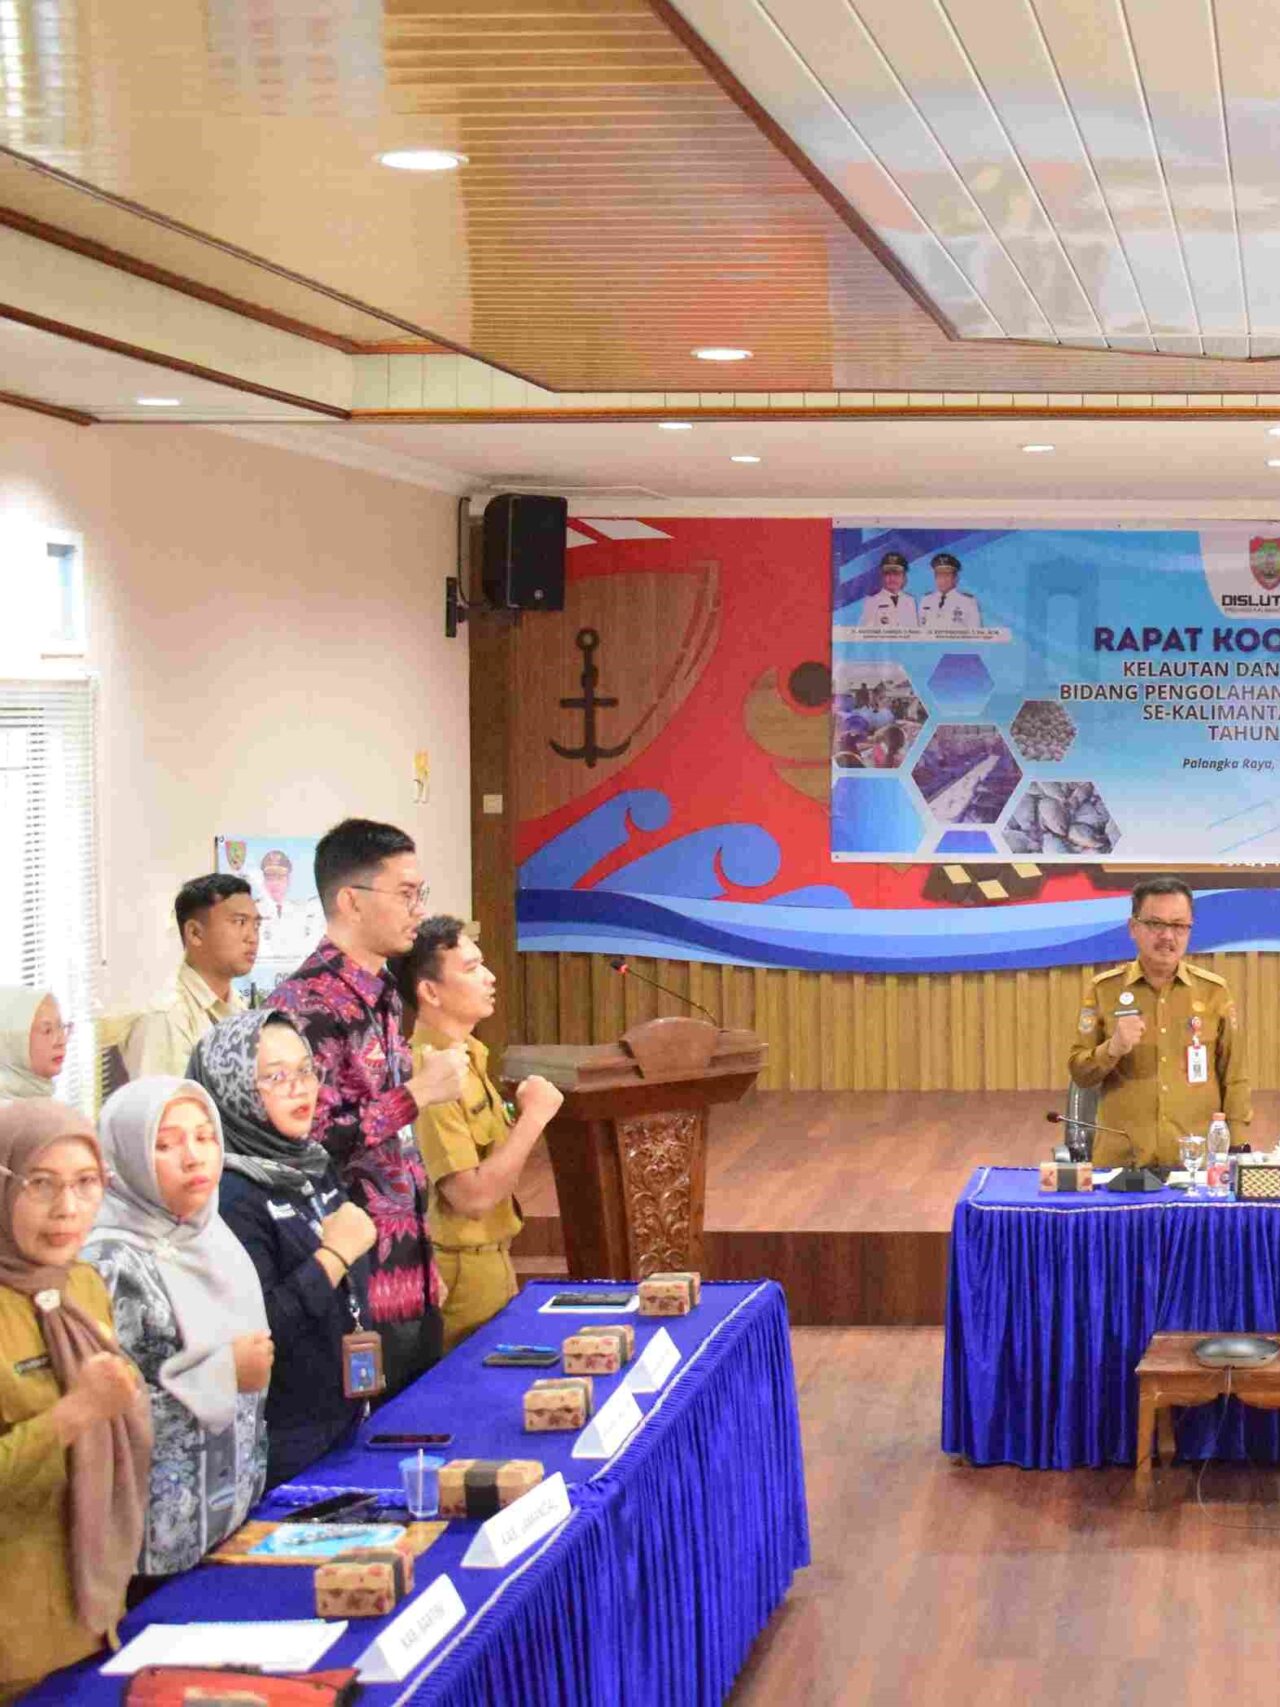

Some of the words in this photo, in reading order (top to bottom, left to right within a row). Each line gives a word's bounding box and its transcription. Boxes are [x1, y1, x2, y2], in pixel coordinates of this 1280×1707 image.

[1093, 626, 1204, 652] RAPAT
[1123, 661, 1229, 678] KELAUTAN
[1236, 661, 1280, 678] DAN
[1060, 684, 1138, 701] BIDANG
[1207, 725, 1280, 741] TAHUN
[1182, 757, 1239, 772] Palangka
[1242, 757, 1275, 772] Raya,
